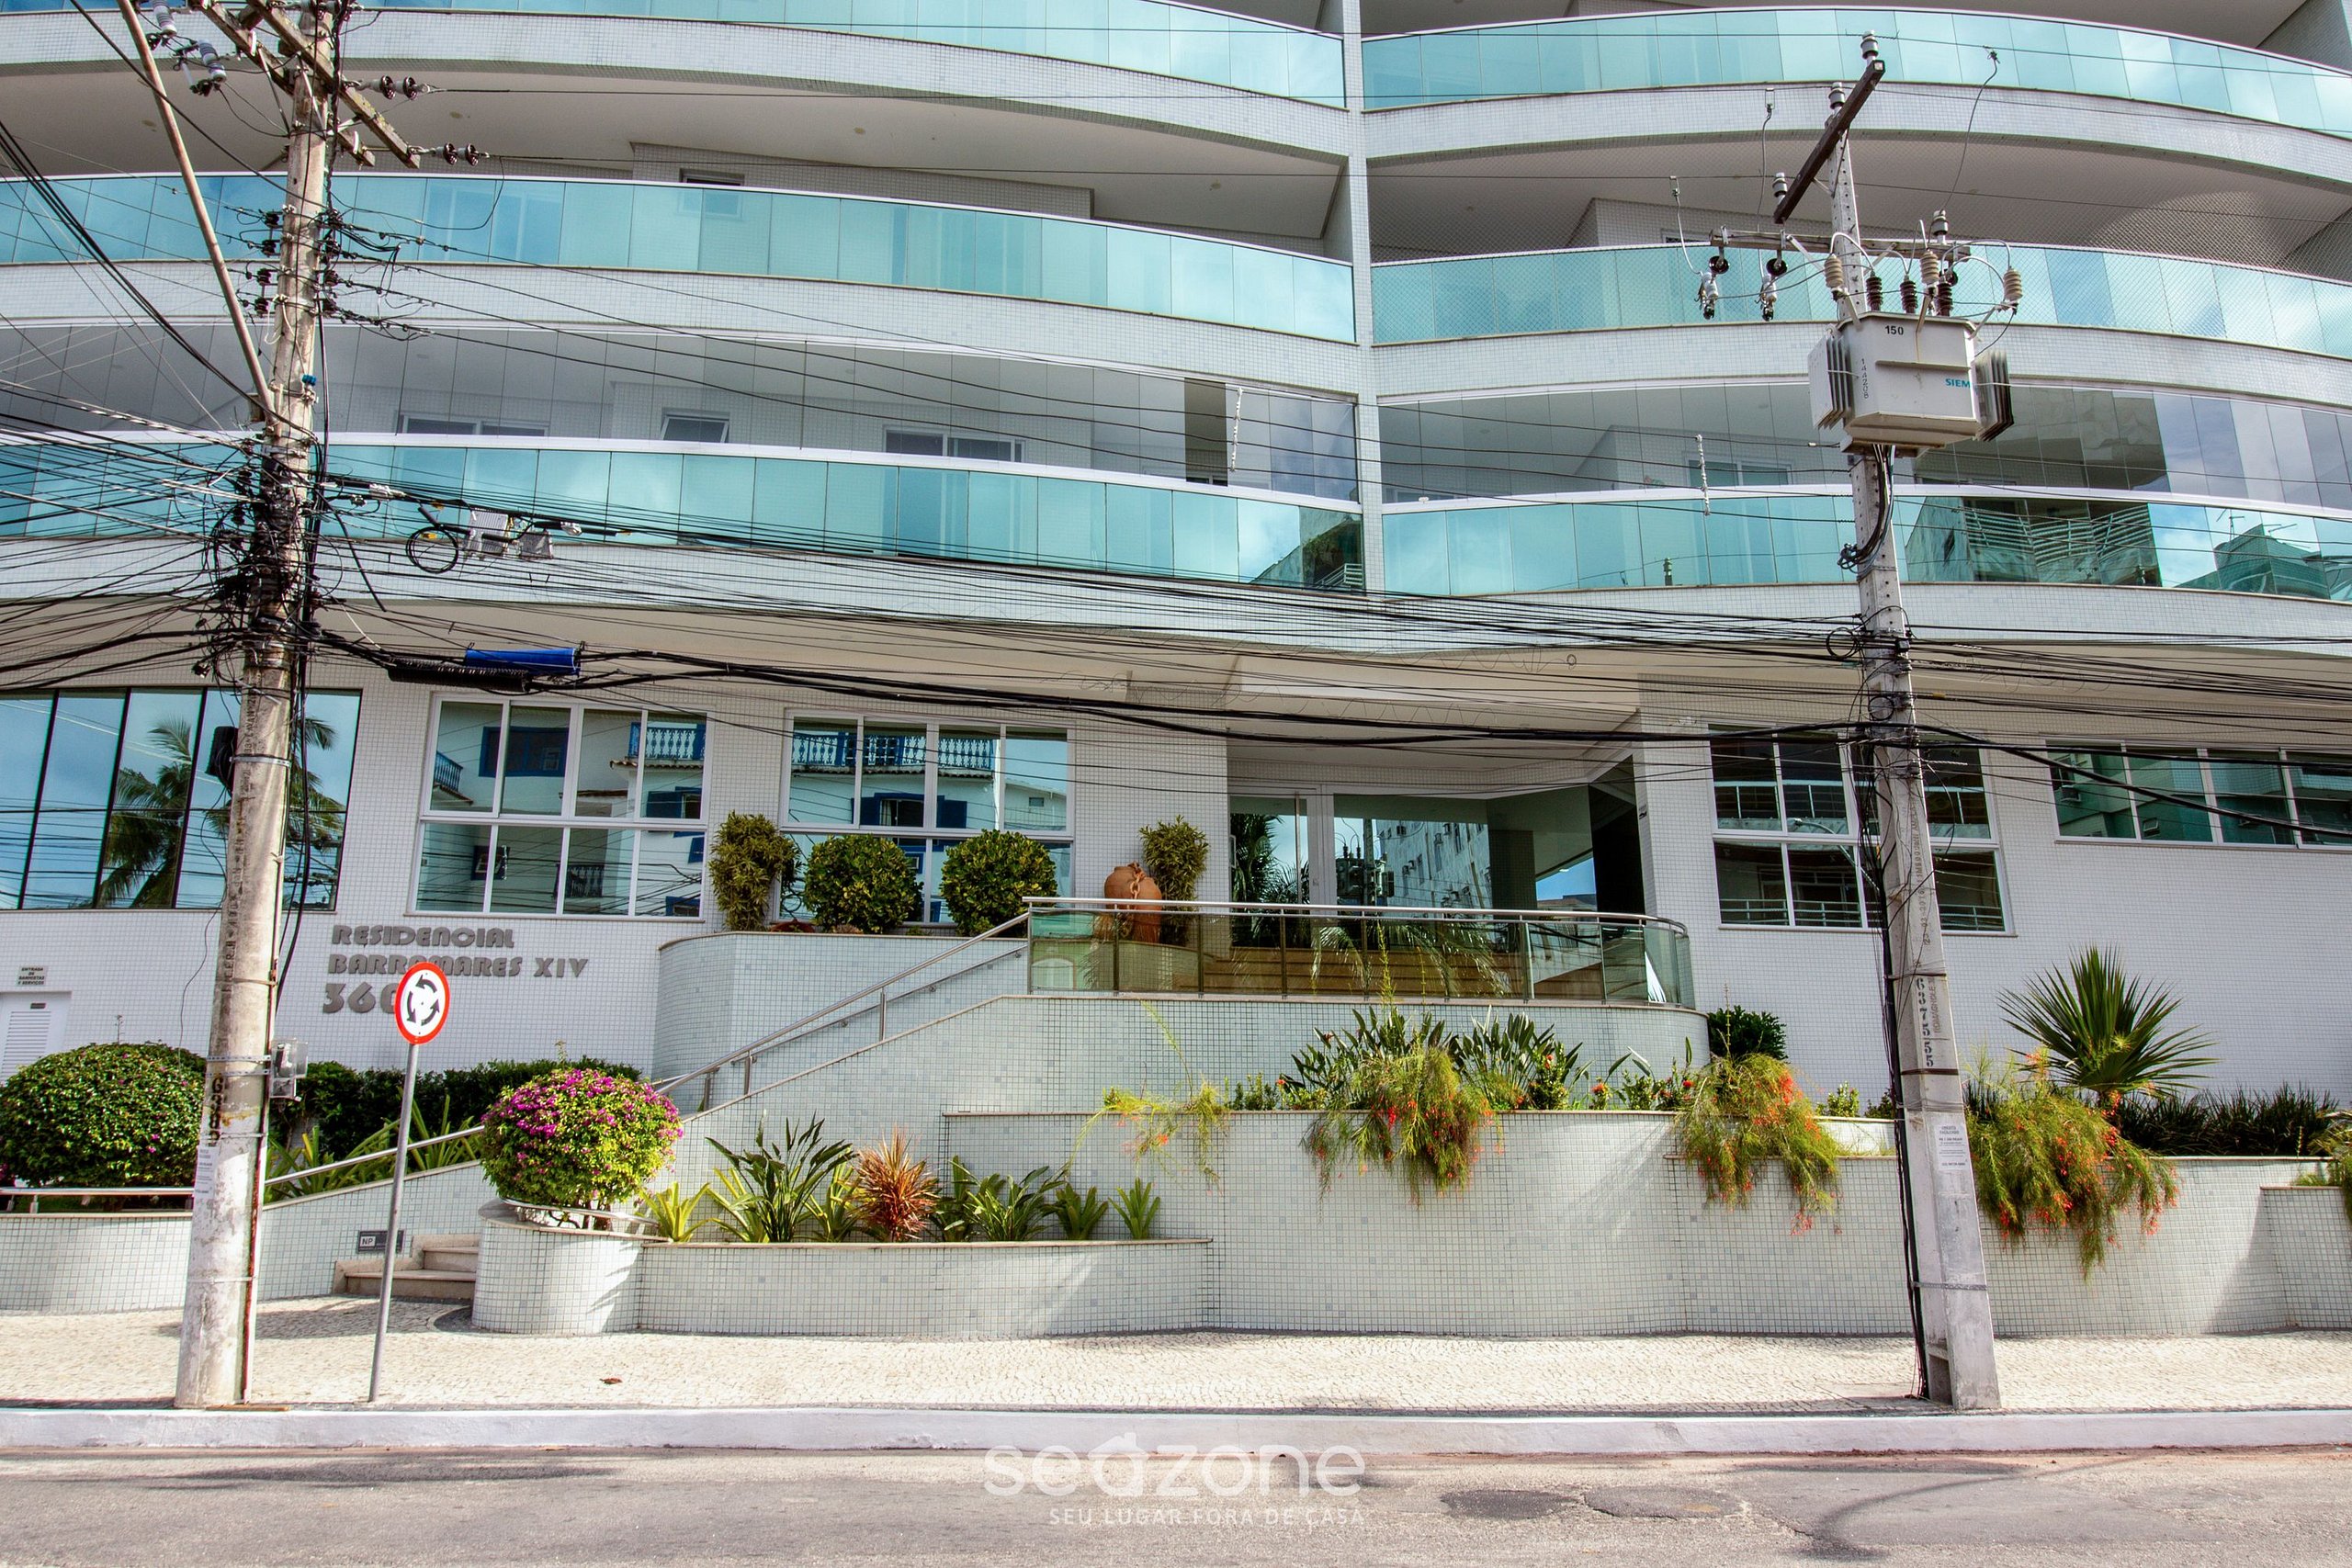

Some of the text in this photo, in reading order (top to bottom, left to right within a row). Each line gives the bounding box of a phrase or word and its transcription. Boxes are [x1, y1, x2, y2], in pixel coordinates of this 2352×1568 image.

[1884, 325, 1905, 335] 150
[1945, 378, 1972, 389] SIEM
[332, 924, 514, 948] RESIDENCIAL
[533, 957, 589, 978] XIV
[361, 1237, 374, 1246] NP
